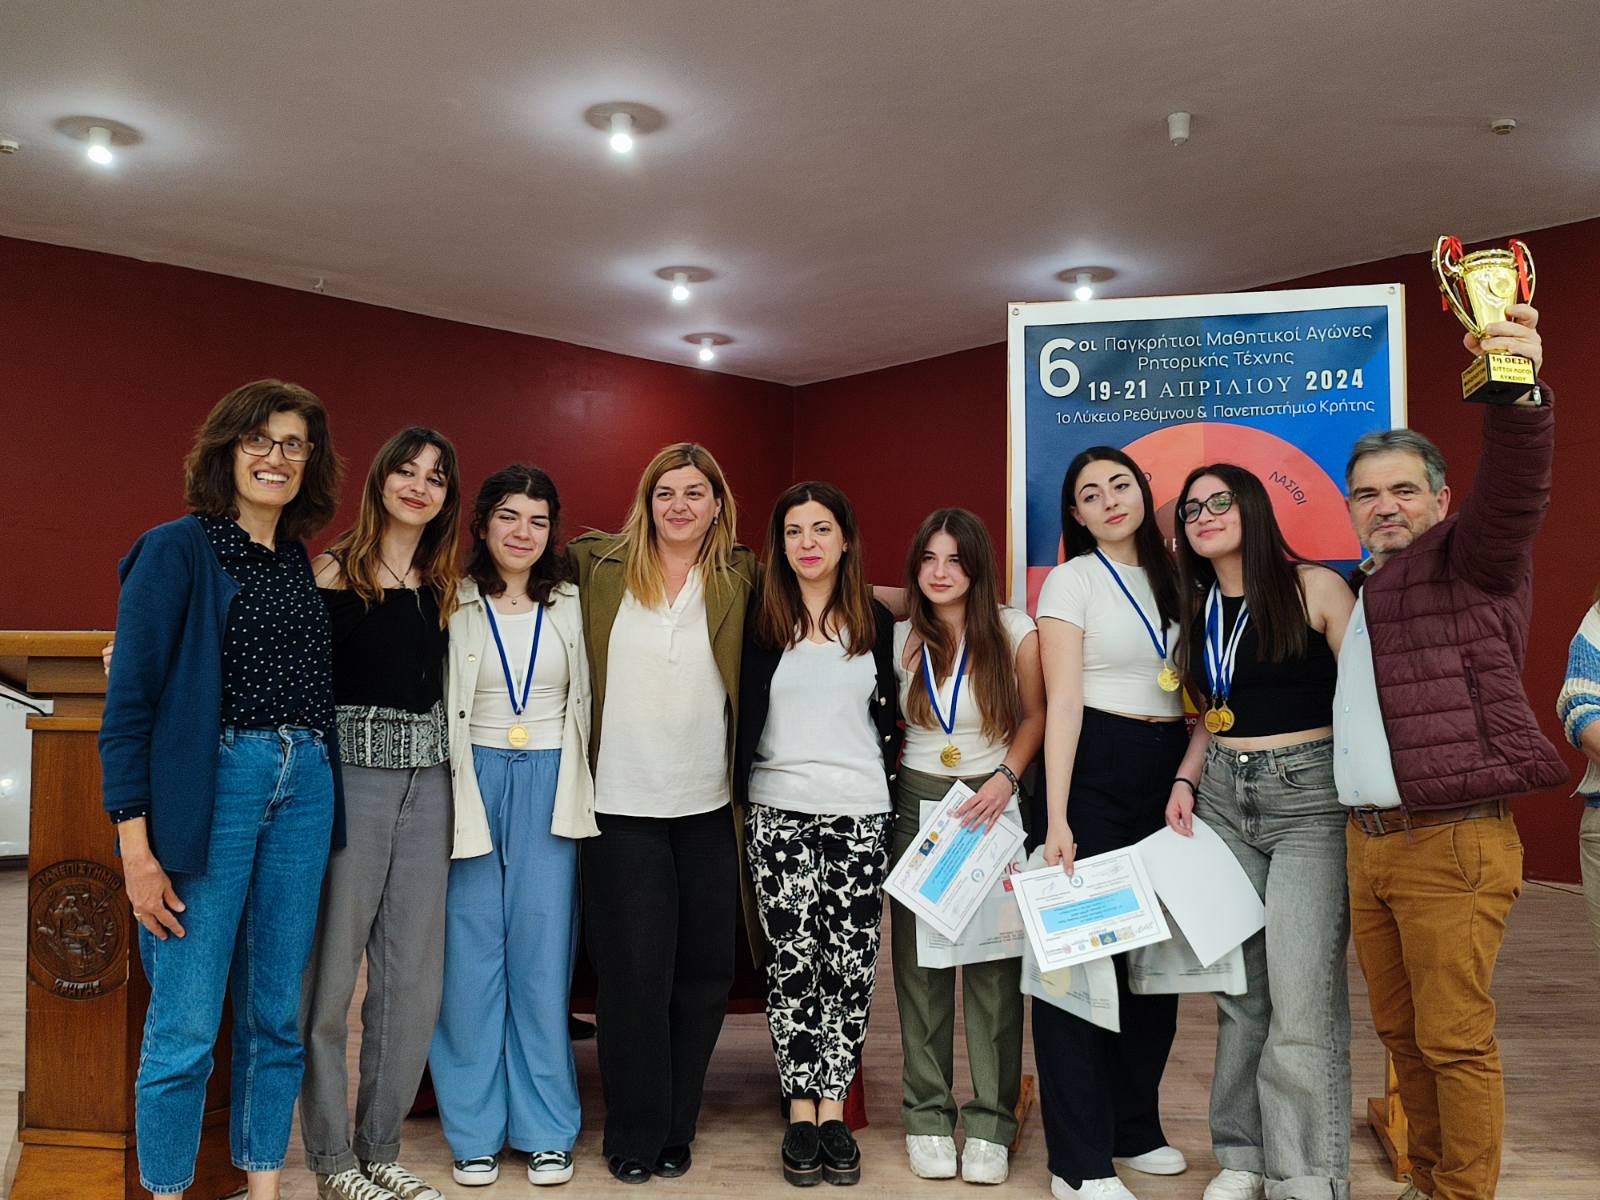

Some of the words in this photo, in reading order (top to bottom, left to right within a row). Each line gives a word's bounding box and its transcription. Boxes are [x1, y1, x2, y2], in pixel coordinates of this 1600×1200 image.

[1104, 334, 1202, 352] Παγκρήτιοι
[1207, 326, 1301, 346] Μαθητικοί
[1306, 324, 1372, 342] Αγώνες
[1138, 352, 1229, 372] Ρητορικής
[1234, 350, 1294, 367] Τέχνης
[1505, 357, 1530, 365] ΘΕΣΗ
[1088, 379, 1147, 401] 19-21
[1159, 376, 1292, 398] ΑΠΡΙΛΙΟΥ
[1305, 368, 1364, 391] 2024
[1056, 412, 1071, 424] 1ο
[1073, 408, 1121, 424] Λύκειο
[1123, 407, 1194, 423] Ρεθύμνου
[1197, 406, 1207, 418] &
[1213, 401, 1317, 418] Πανεπιστήμιο
[1319, 398, 1375, 415] Κρήτης
[1269, 471, 1307, 505] ΛΑΣΙΘΙ
[38, 863, 122, 891] ΠΑΝΕΠΙΣΤΗΜΙΟ
